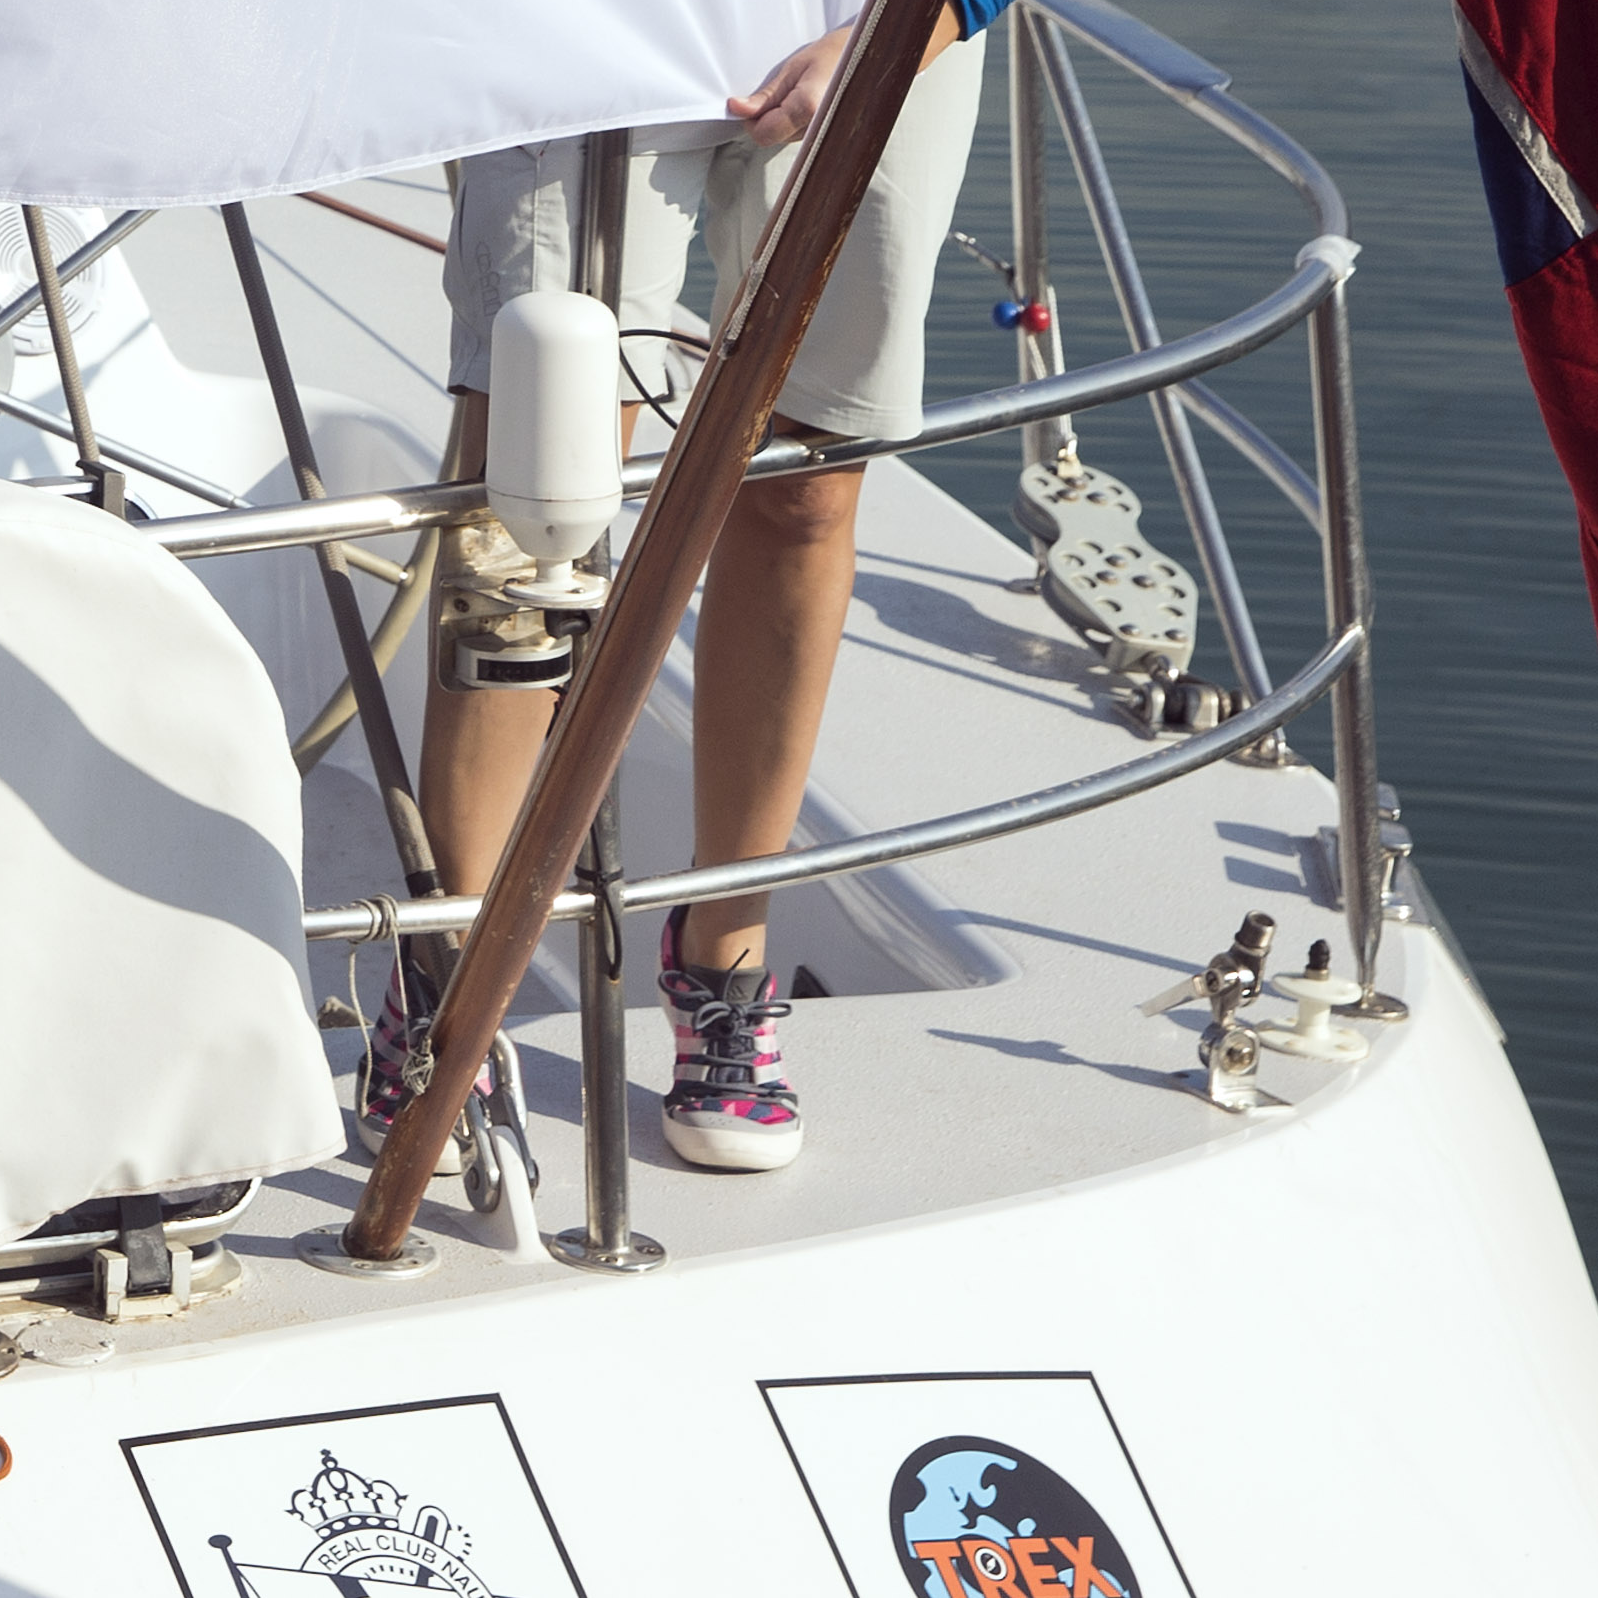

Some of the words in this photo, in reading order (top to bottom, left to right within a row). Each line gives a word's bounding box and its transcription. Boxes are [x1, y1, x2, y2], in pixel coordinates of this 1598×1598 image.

[318, 1536, 371, 1571] REAL
[376, 1534, 438, 1565] CLUB
[913, 1536, 1123, 1598] TREX
